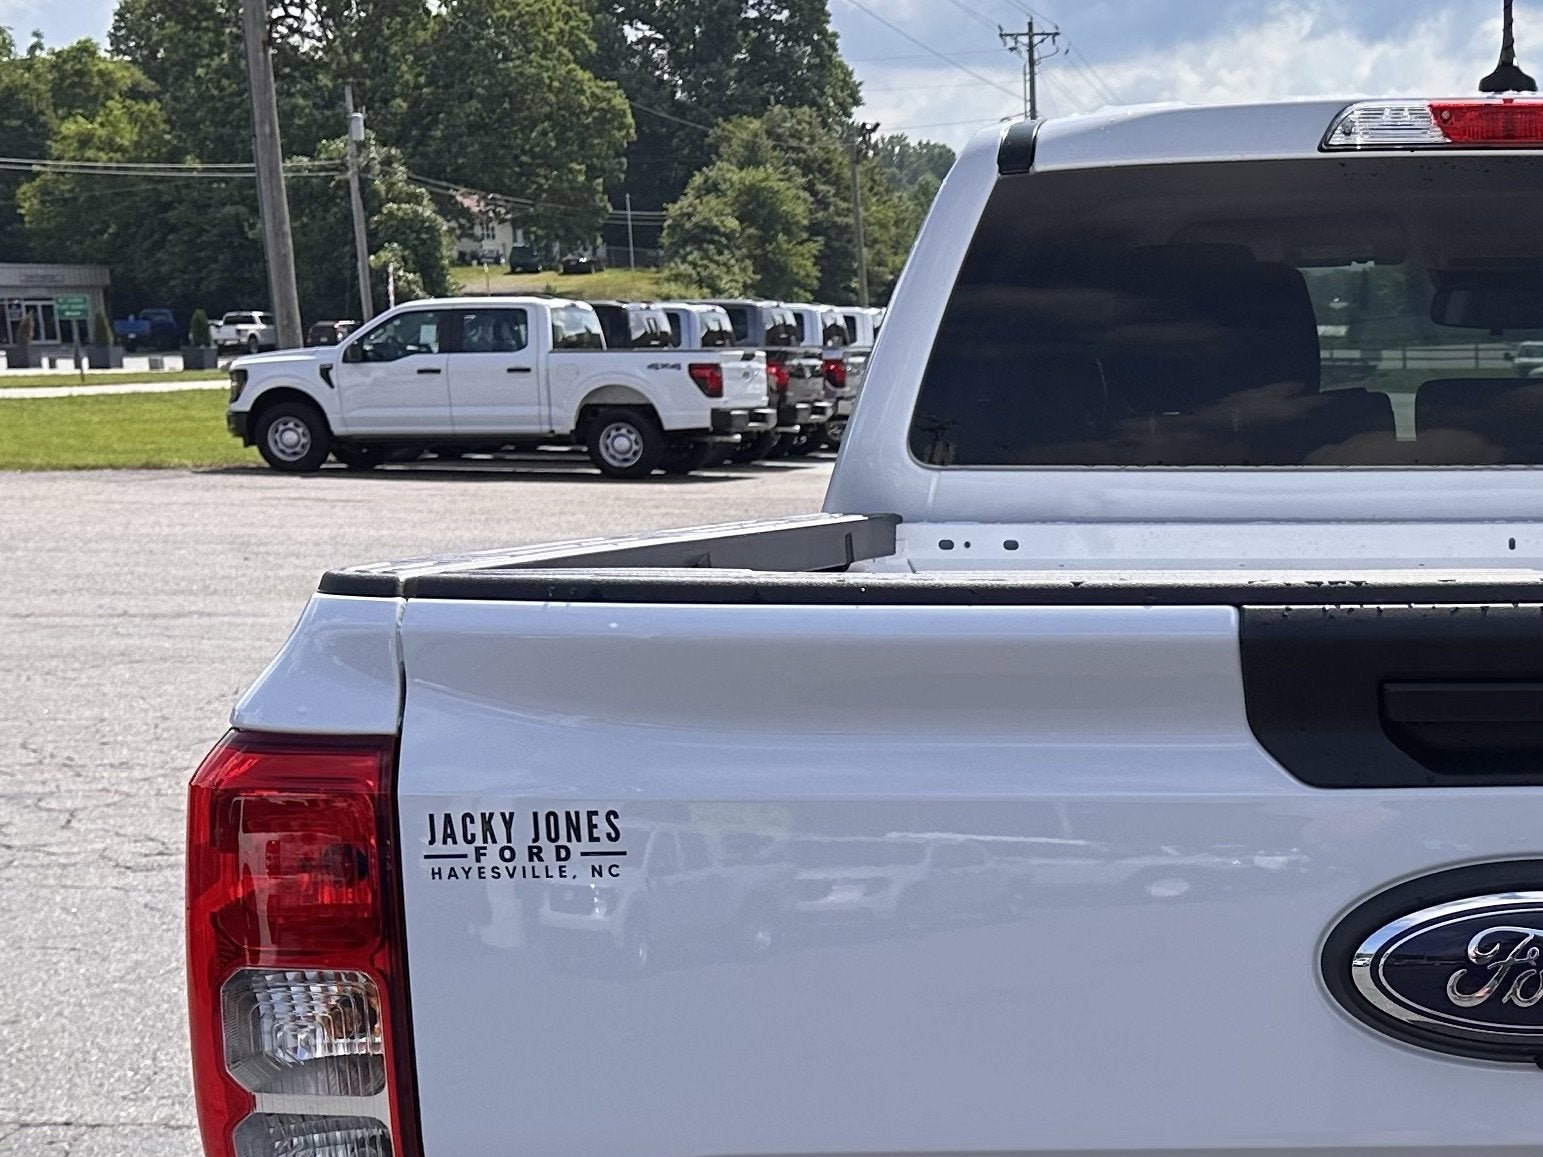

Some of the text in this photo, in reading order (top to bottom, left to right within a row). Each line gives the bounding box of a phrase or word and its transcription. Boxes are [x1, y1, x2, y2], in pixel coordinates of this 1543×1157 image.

[428, 810, 621, 846] JACKY JONES
[474, 845, 572, 863] FORD
[431, 864, 621, 880] HAYESVILLE, NC
